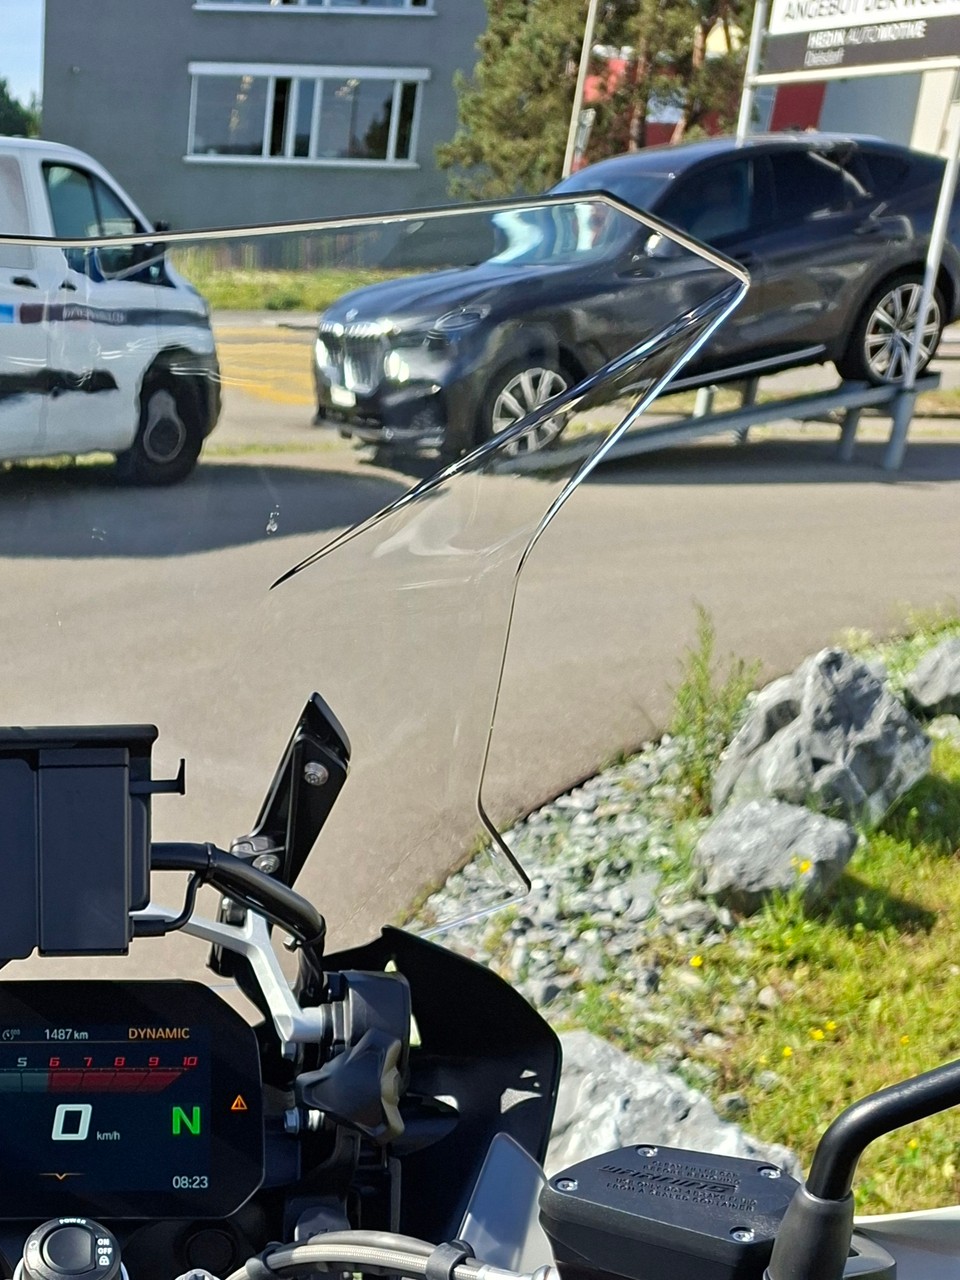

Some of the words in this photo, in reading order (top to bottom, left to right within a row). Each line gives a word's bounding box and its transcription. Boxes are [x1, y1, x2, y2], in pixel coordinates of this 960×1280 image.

[45, 1029, 72, 1040] 1487
[74, 1031, 89, 1040] km
[128, 1027, 190, 1040] DYNAMIC
[17, 1057, 28, 1067] 5
[49, 1057, 60, 1067] 6
[83, 1057, 93, 1067] 7
[114, 1057, 126, 1067] 8
[148, 1057, 160, 1067] 9
[182, 1056, 199, 1066] 10
[51, 1103, 93, 1141] 0
[96, 1130, 121, 1141] km/h
[171, 1106, 201, 1135] N
[172, 1176, 208, 1189] 08:23
[97, 1238, 110, 1246] ON
[97, 1247, 112, 1255] OFF
